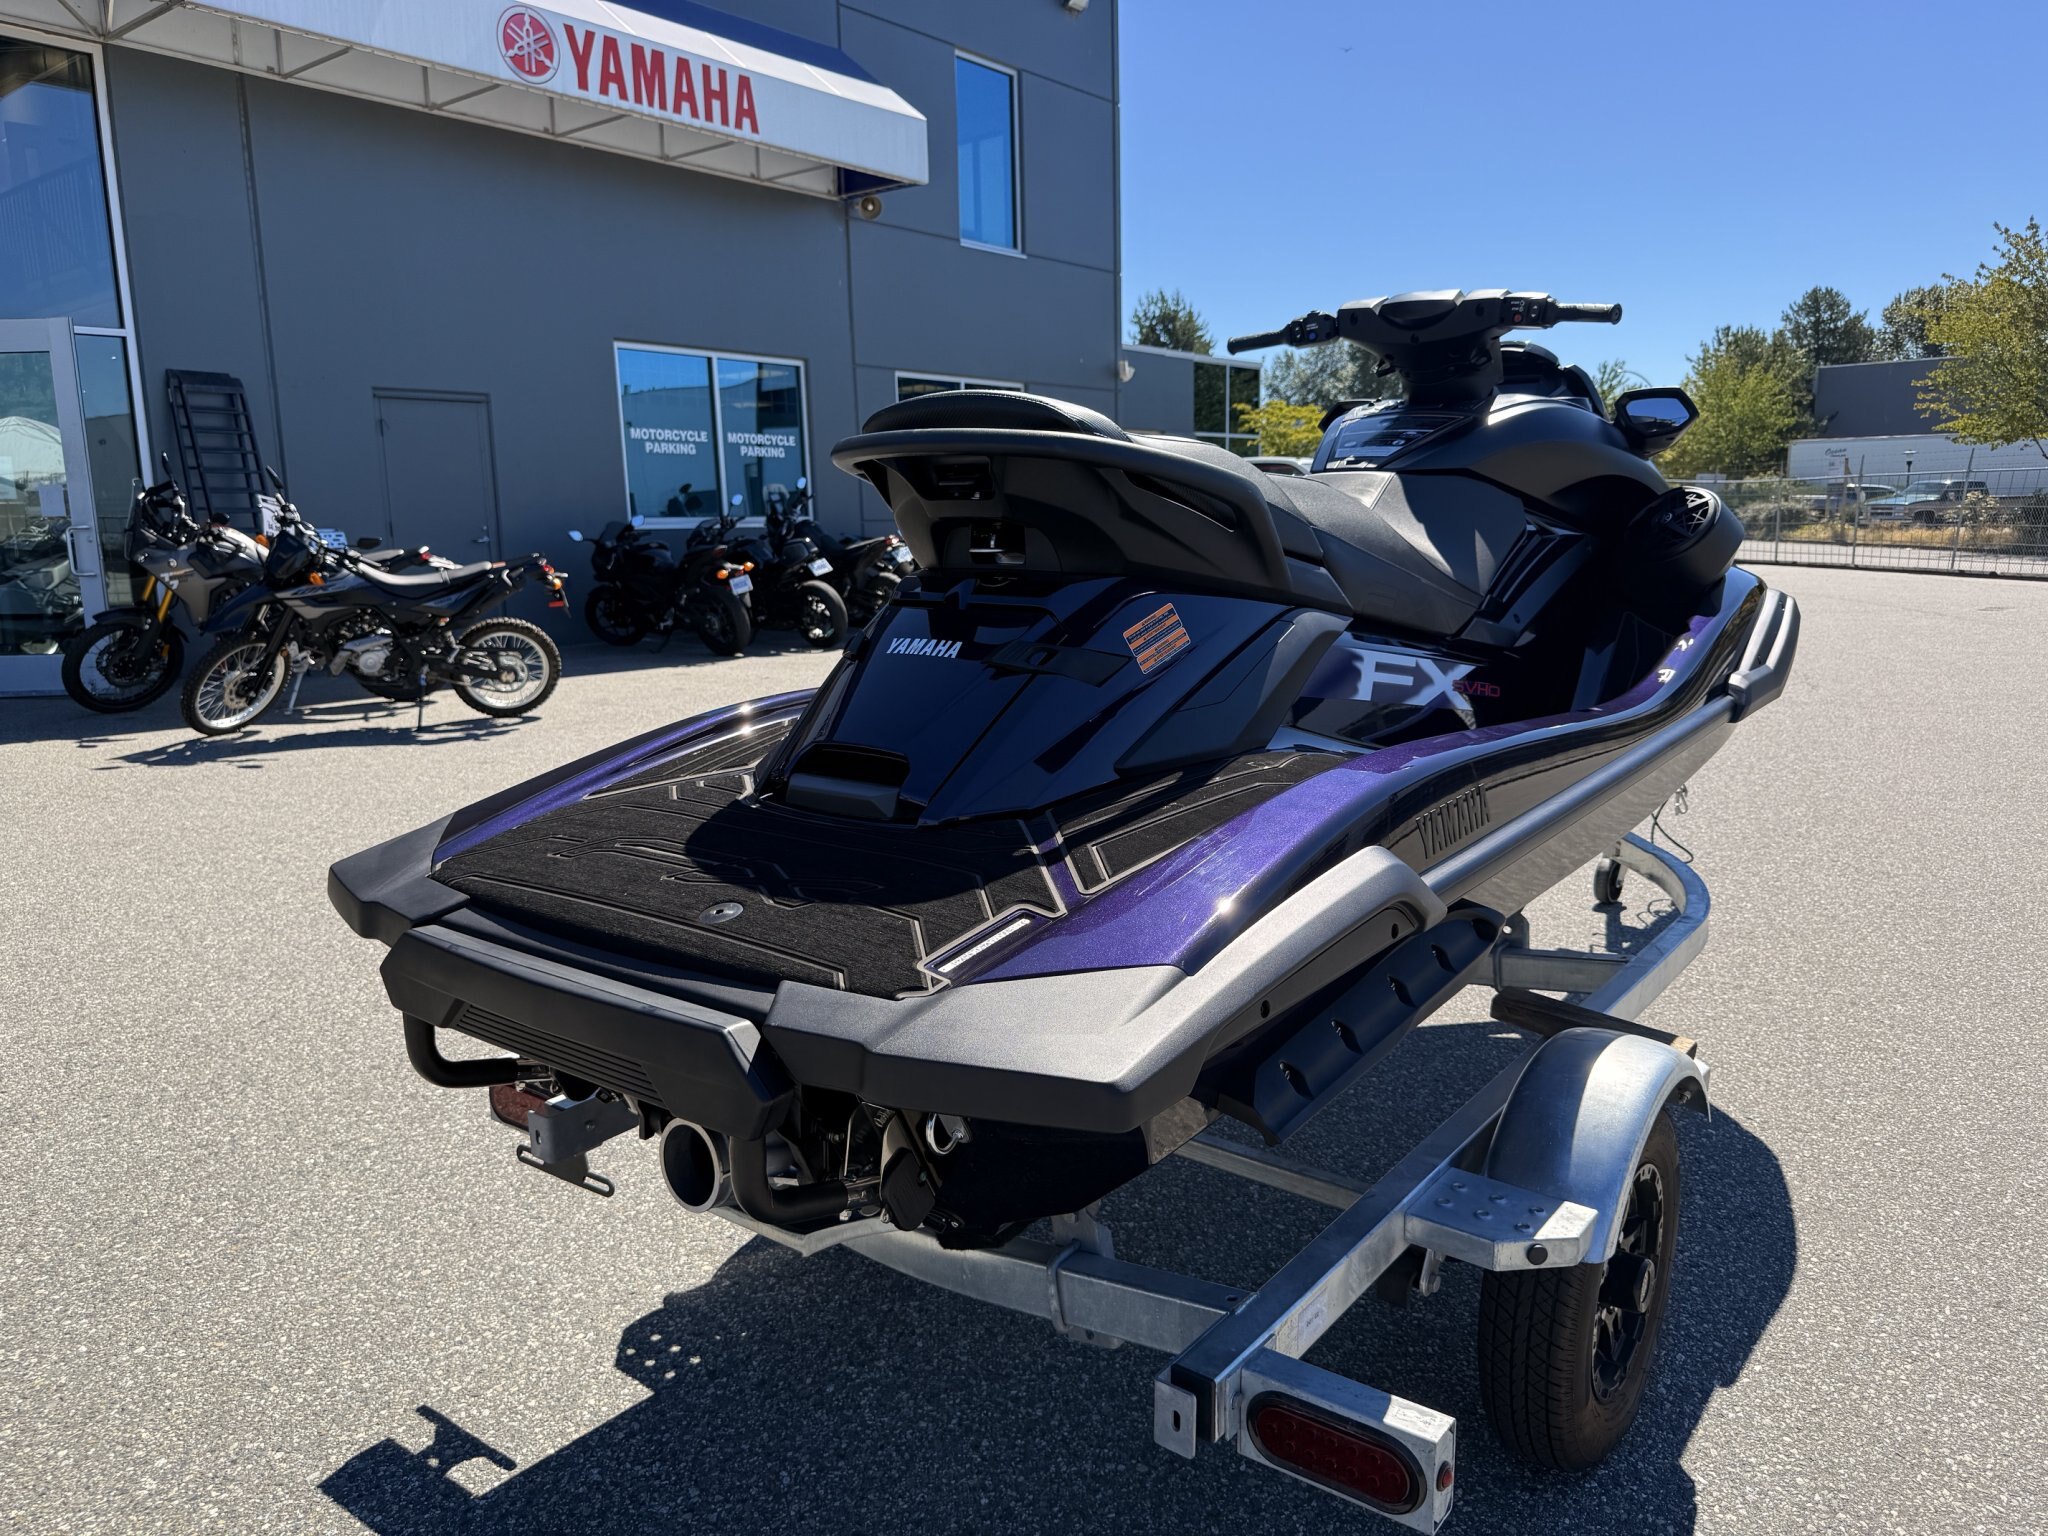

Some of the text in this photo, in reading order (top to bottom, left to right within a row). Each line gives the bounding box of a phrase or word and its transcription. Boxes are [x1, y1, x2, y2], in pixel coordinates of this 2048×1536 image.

[562, 23, 759, 135] YAMAHA
[630, 427, 708, 443] MOTORCYCLE
[727, 432, 796, 446] MOTORCYCLE
[645, 441, 696, 455] PARKING
[740, 445, 786, 458] PARKING
[886, 638, 962, 659] YAMAHA
[1351, 649, 1477, 711] FX
[1416, 783, 1490, 860] YAMAHA
